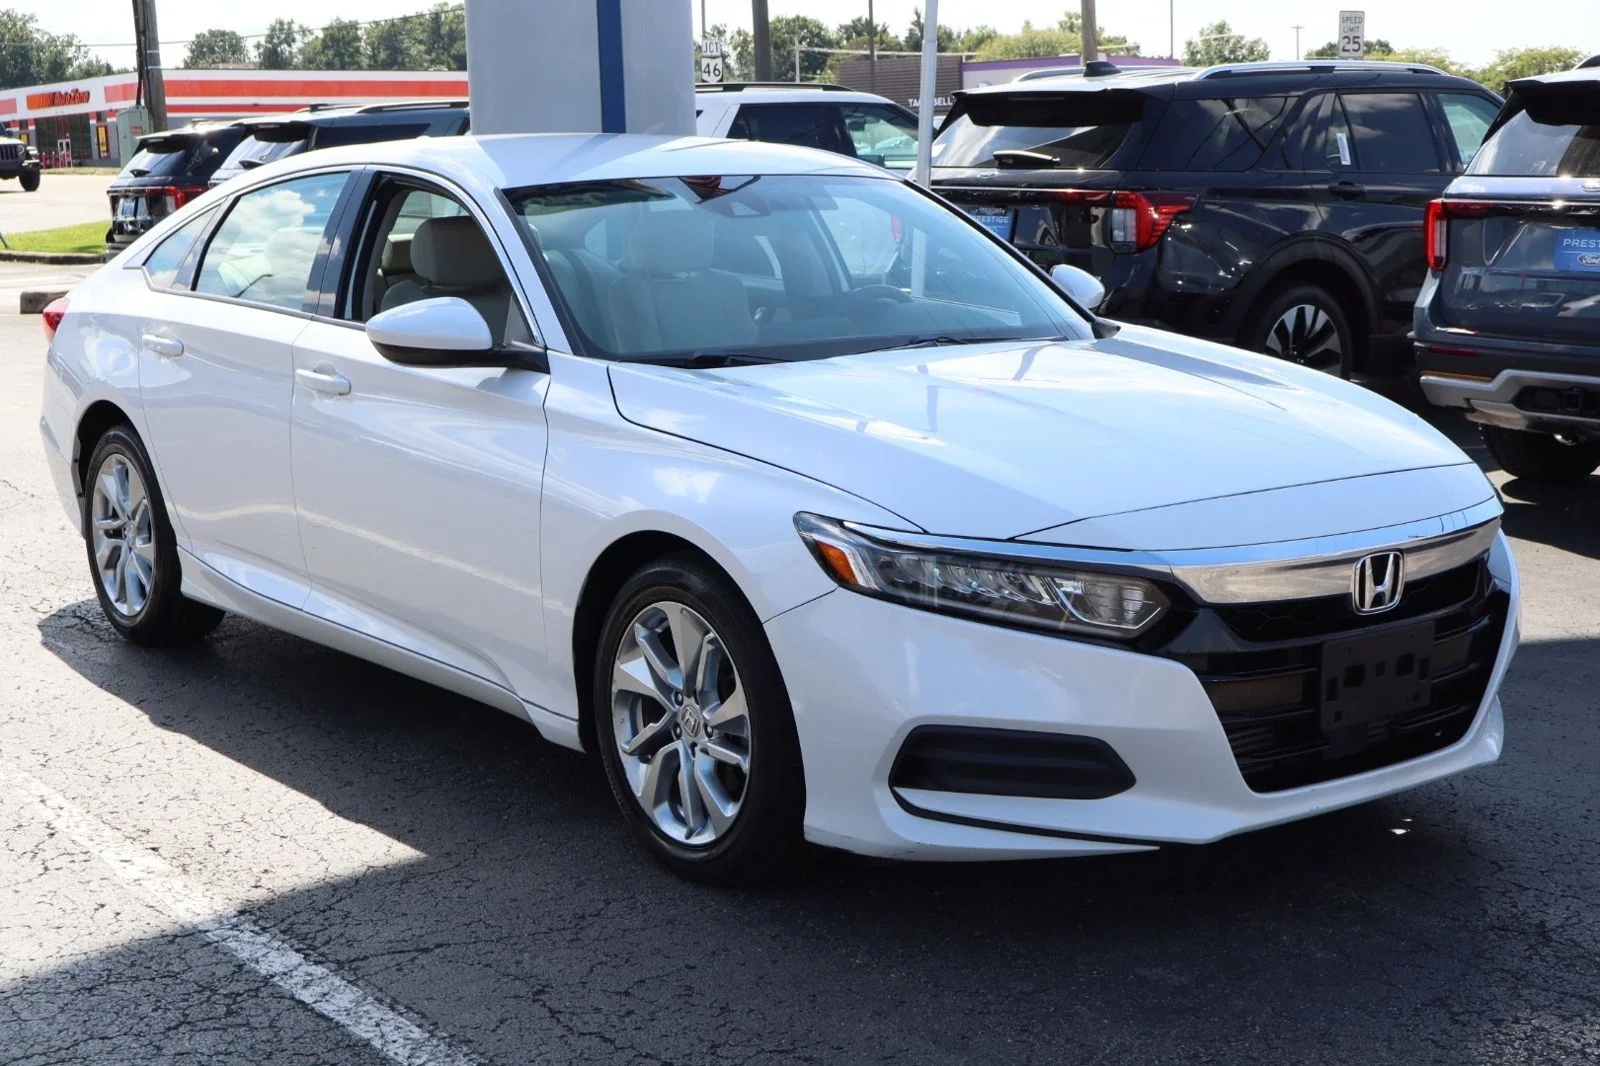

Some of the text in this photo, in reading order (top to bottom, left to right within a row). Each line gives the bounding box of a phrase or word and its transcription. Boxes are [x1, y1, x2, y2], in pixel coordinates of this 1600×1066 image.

[1341, 16, 1363, 24] SPEED
[703, 42, 719, 53] JCT
[1341, 35, 1361, 52] 25
[703, 63, 721, 77] 46
